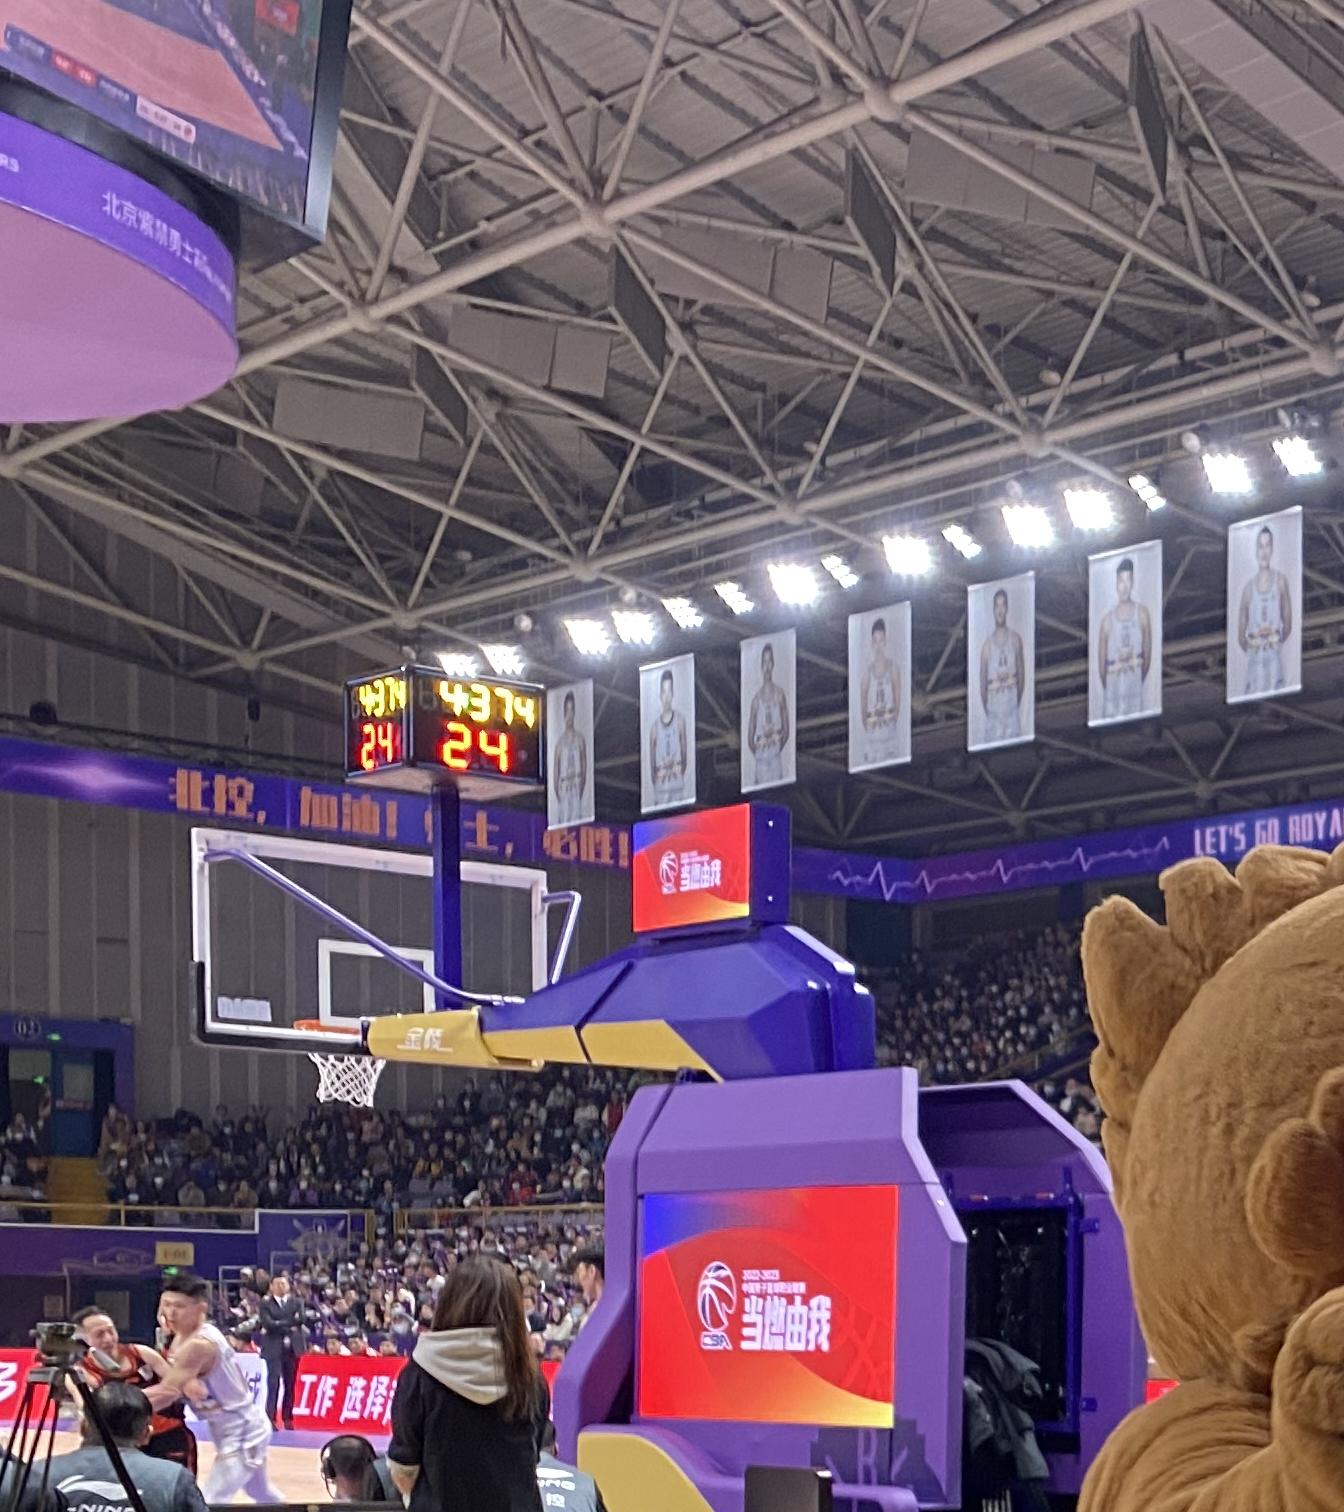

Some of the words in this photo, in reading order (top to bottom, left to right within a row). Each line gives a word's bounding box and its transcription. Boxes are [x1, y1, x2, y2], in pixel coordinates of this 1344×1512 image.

[443, 722, 508, 772] 24
[1193, 822, 1246, 857] LET'S
[1255, 815, 1280, 845] GO
[292, 1374, 338, 1418] 工作
